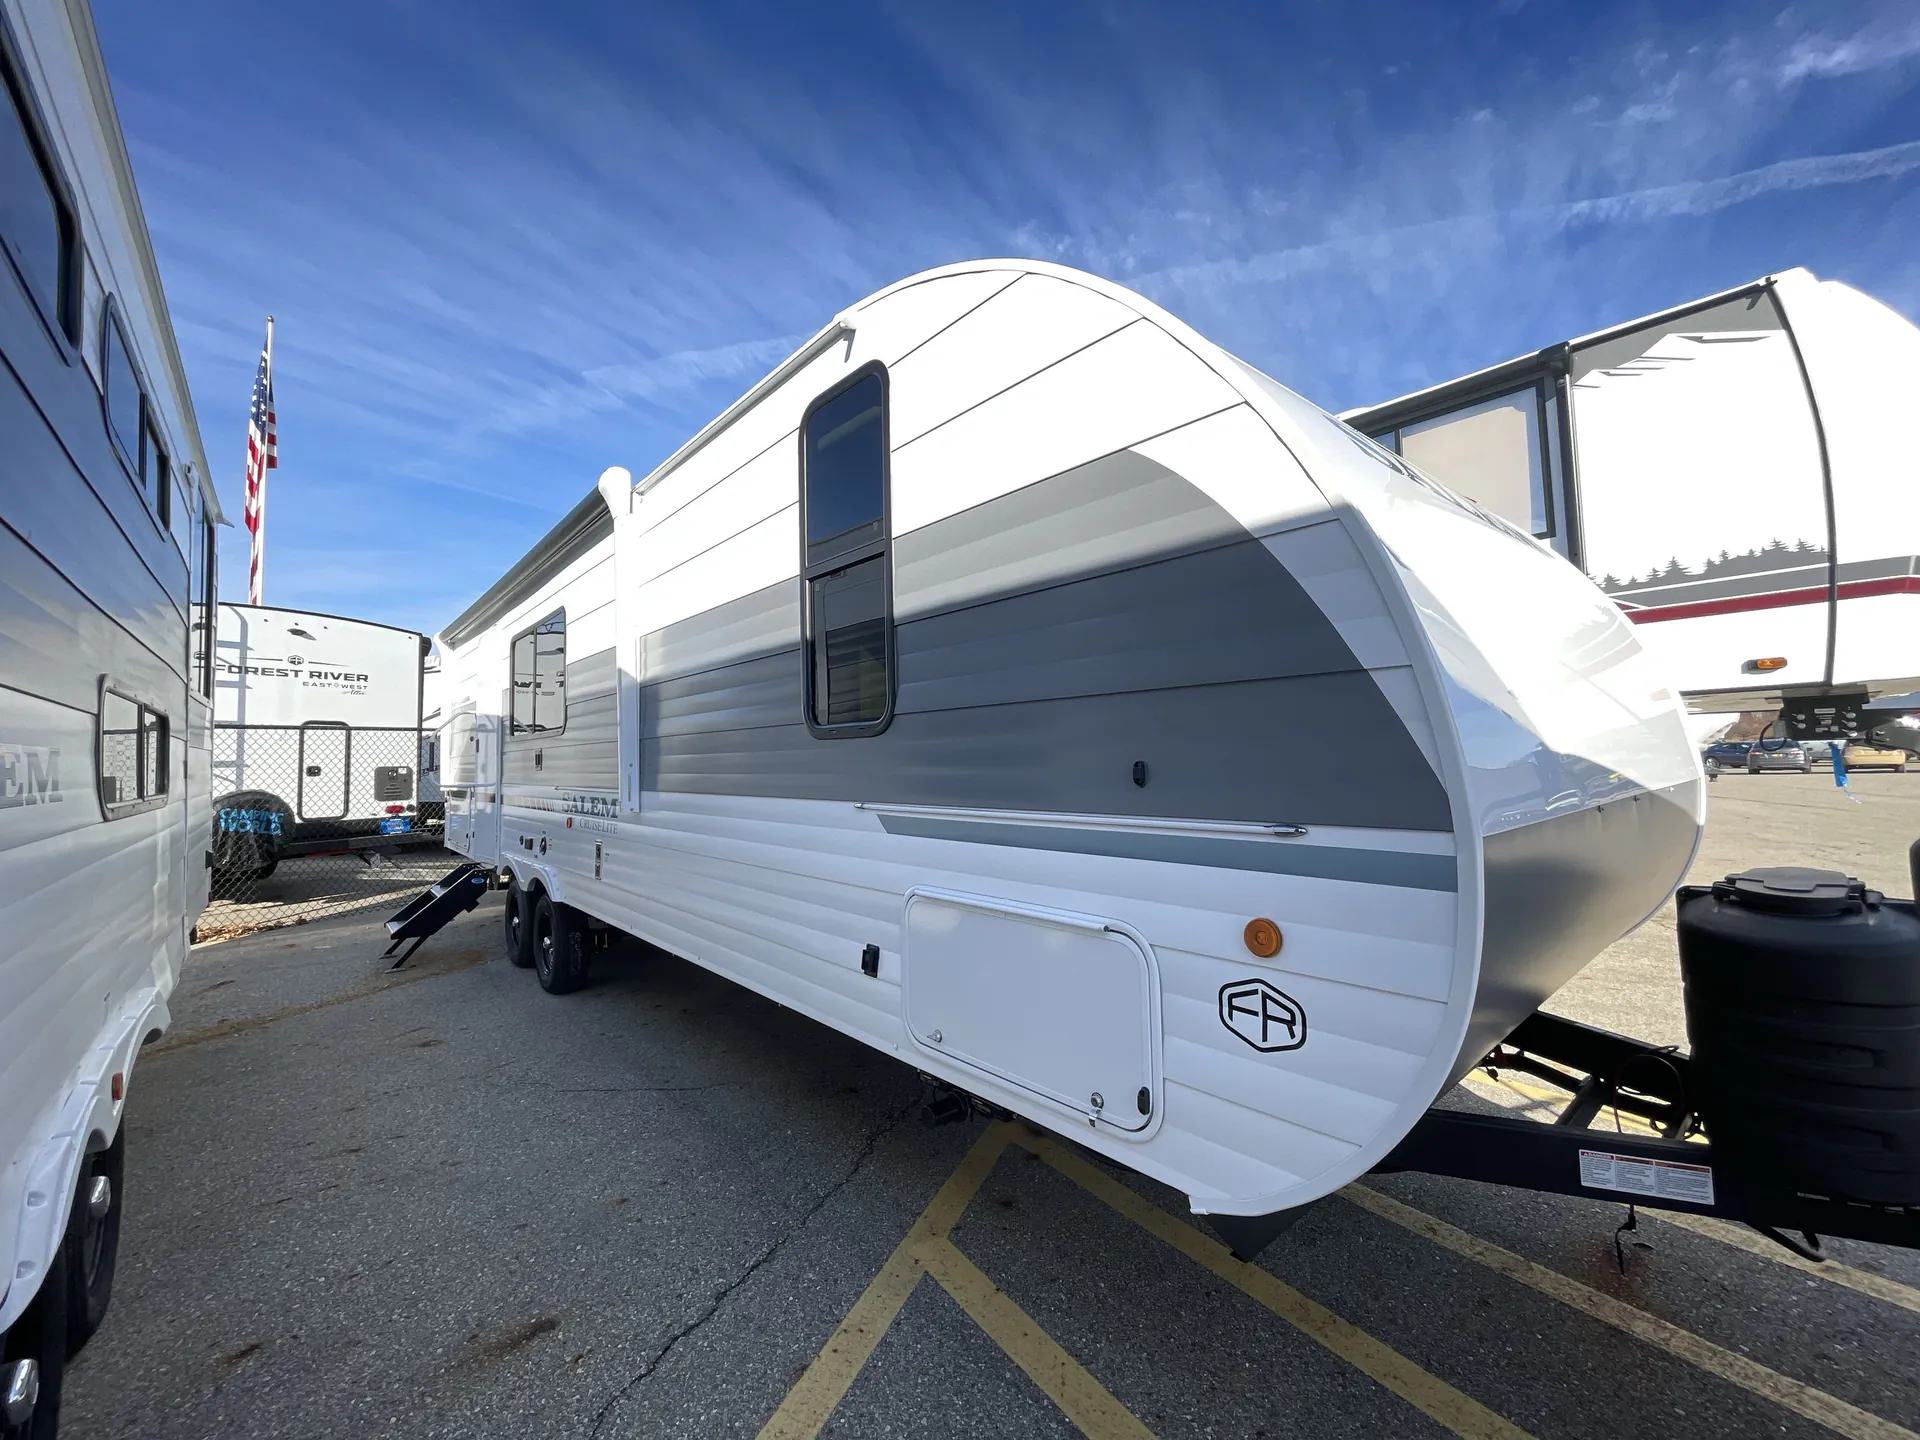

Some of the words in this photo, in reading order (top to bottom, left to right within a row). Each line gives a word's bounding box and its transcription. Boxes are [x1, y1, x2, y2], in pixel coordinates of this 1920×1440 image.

[308, 670, 369, 683] RIVER
[561, 791, 619, 819] SALEM
[219, 807, 284, 823] CAMPING
[219, 818, 282, 836] WORLD
